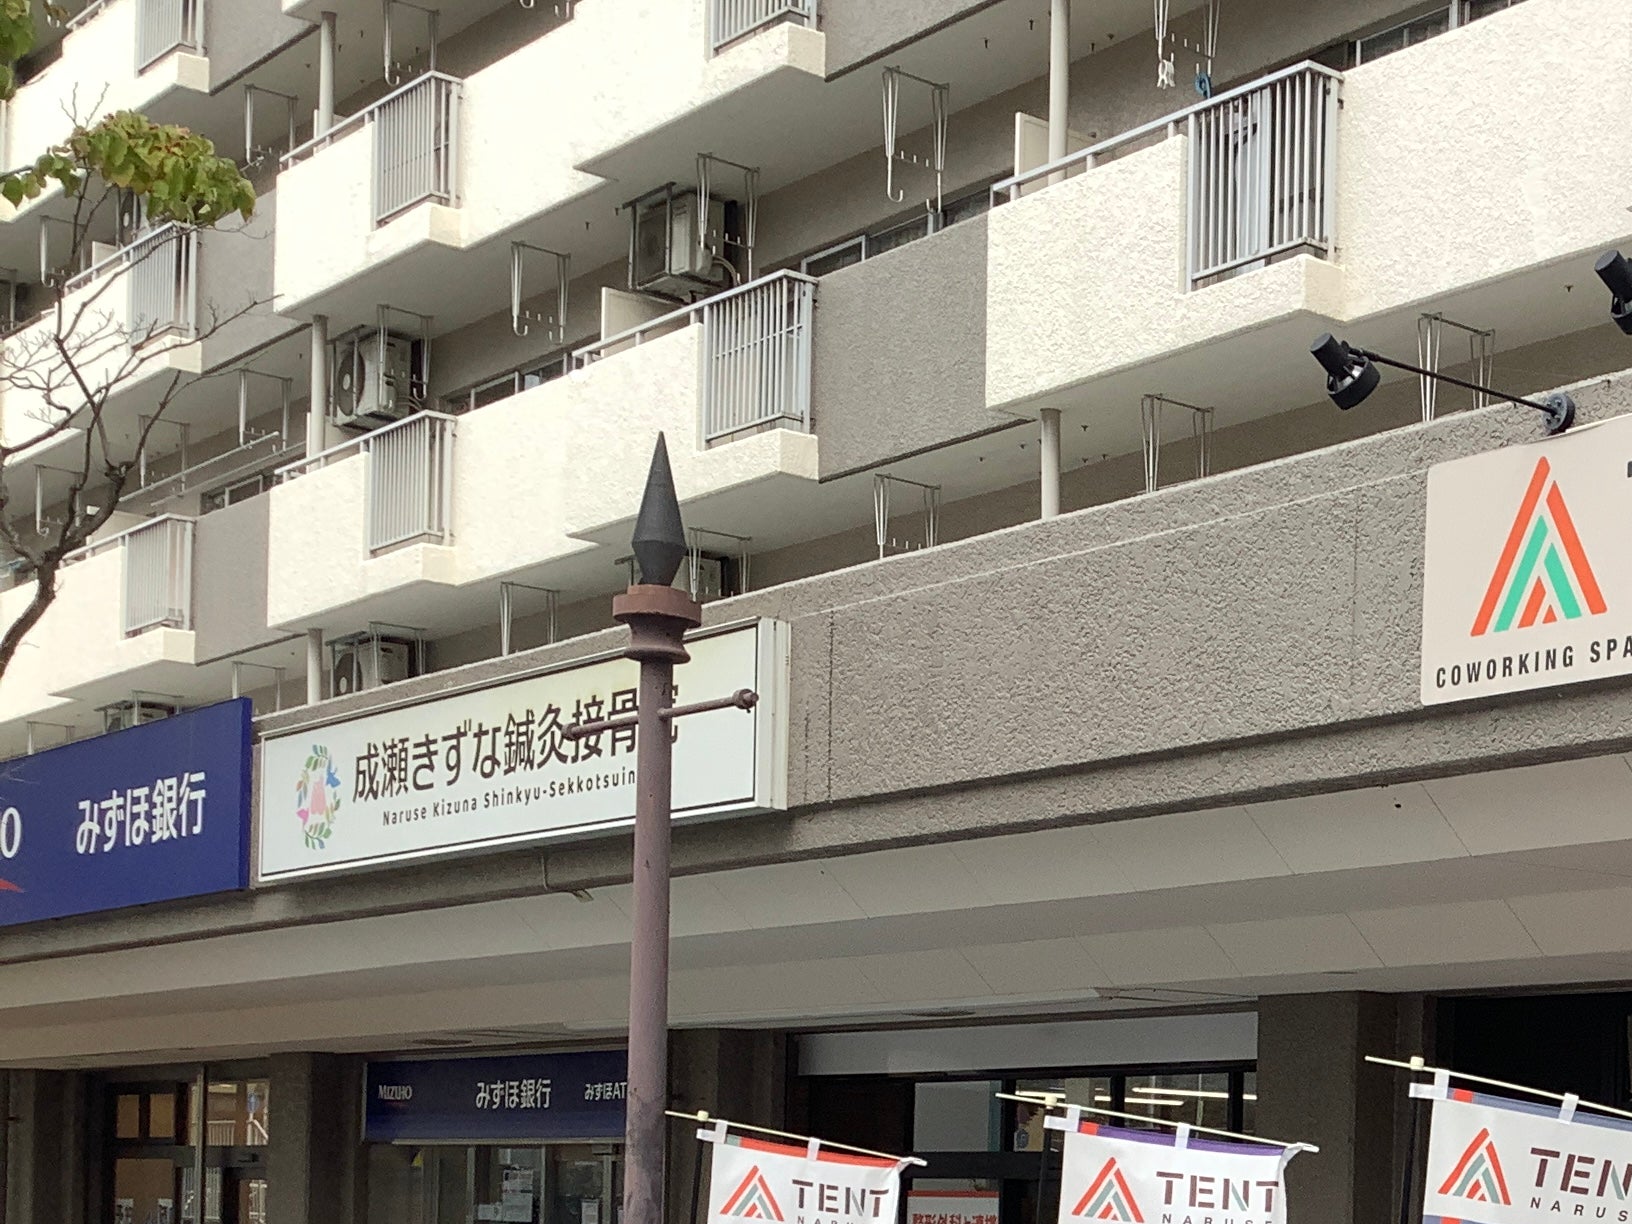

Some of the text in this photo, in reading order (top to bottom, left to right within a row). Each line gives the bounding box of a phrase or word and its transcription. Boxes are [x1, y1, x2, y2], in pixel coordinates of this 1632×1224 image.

[1435, 645, 1575, 689] COWORKING
[352, 684, 678, 804] 成瀬きずな鍼灸接骨
[76, 771, 207, 855] みずほ銀行
[382, 767, 637, 826] Naruse Kizuna Shinkyu-Sekkotsuin
[378, 1084, 413, 1100] MIZUHO
[475, 1078, 552, 1109] みずほ銀行
[584, 1081, 628, 1101] みずほAT
[792, 1178, 889, 1218] TENT
[1156, 1171, 1279, 1213] TENT
